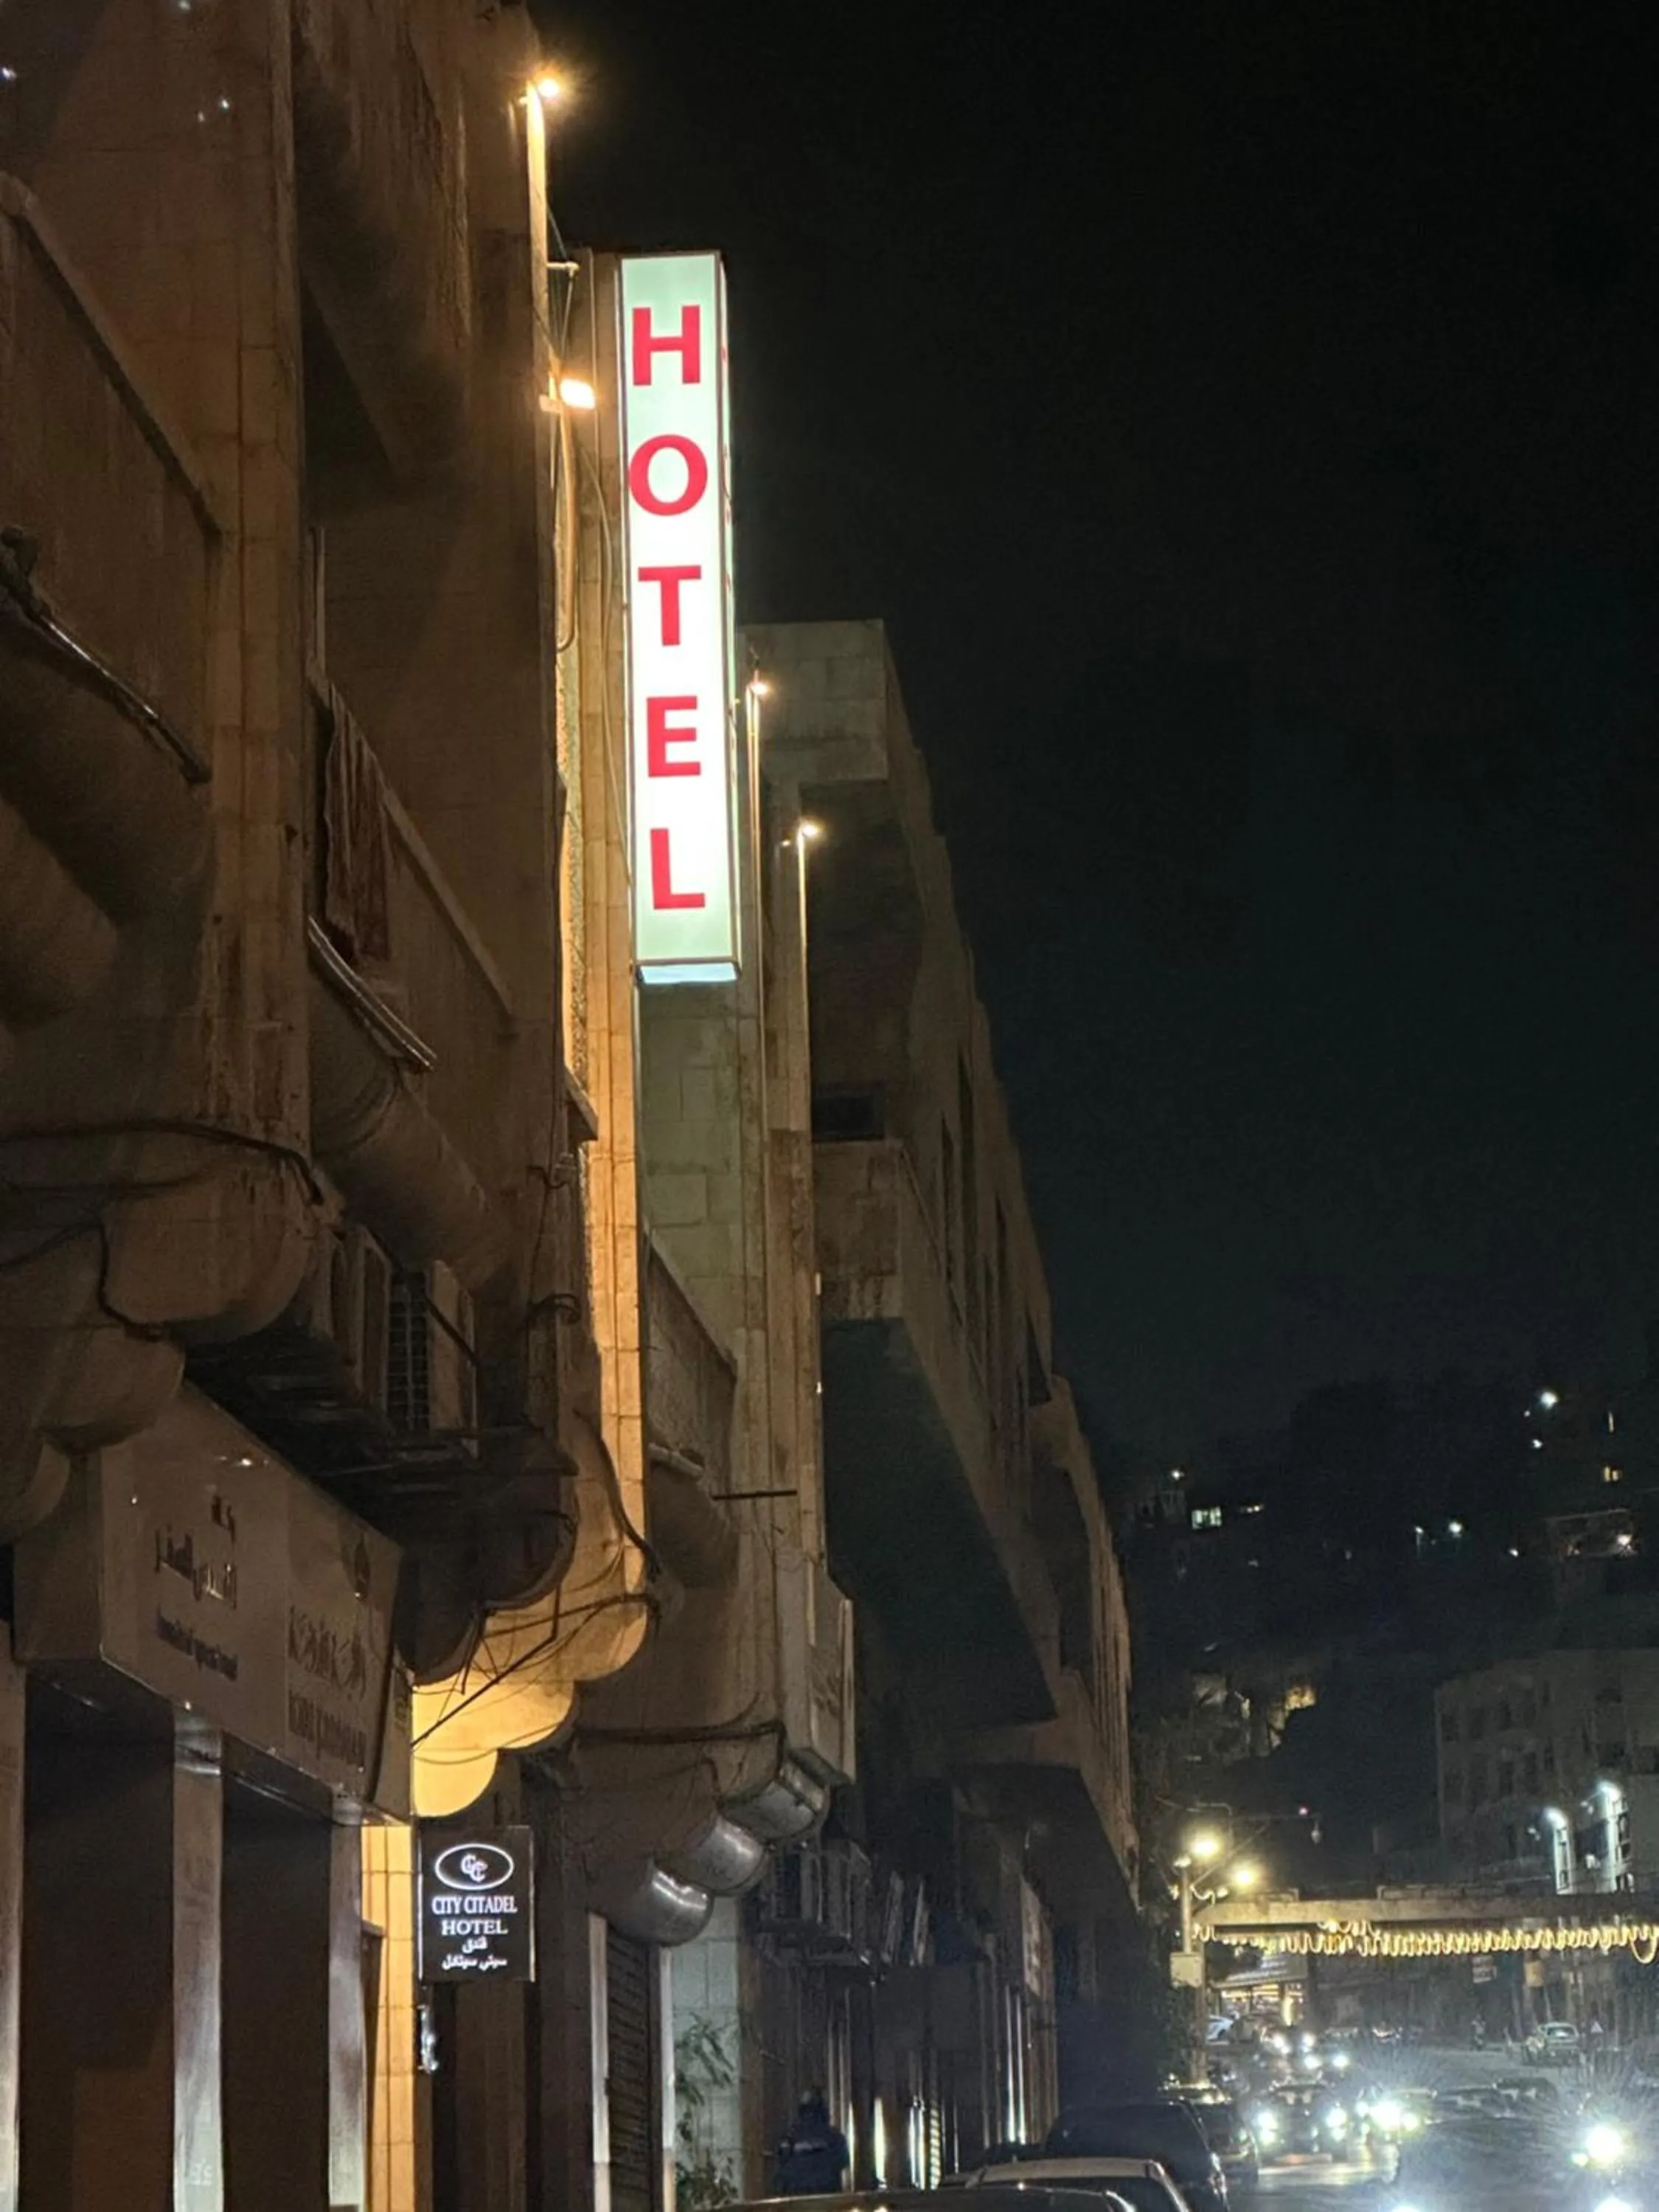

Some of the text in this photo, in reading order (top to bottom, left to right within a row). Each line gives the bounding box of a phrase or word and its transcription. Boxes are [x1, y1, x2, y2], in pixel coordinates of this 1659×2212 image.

[627, 306, 708, 909] HOTEL
[431, 1893, 518, 1916] CITY CITADEL
[441, 1918, 509, 1936] HOTEL
